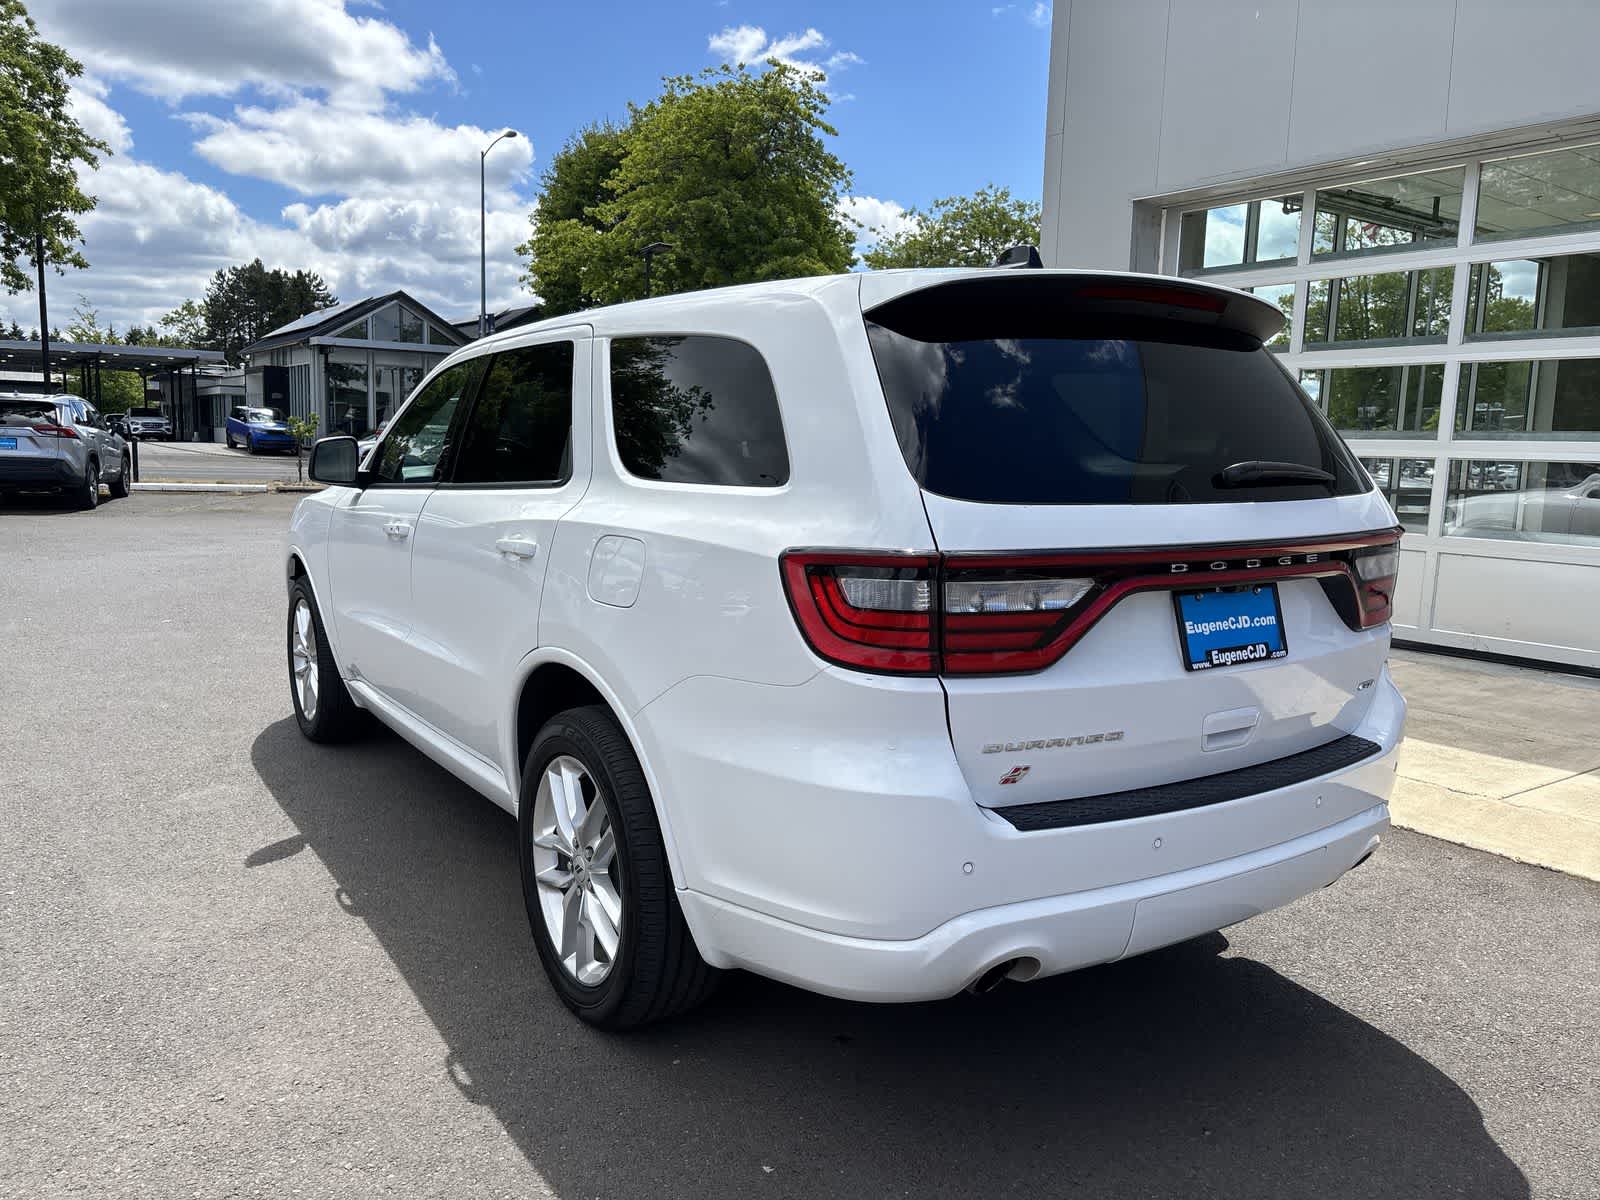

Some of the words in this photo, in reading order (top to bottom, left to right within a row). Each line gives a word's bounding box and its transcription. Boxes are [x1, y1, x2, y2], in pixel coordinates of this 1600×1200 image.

[1171, 553, 1319, 572] DODGE
[1185, 615, 1276, 635] EugeneCJD.com
[1211, 644, 1267, 665] EugeneCJD
[982, 731, 1124, 754] DURANGO
